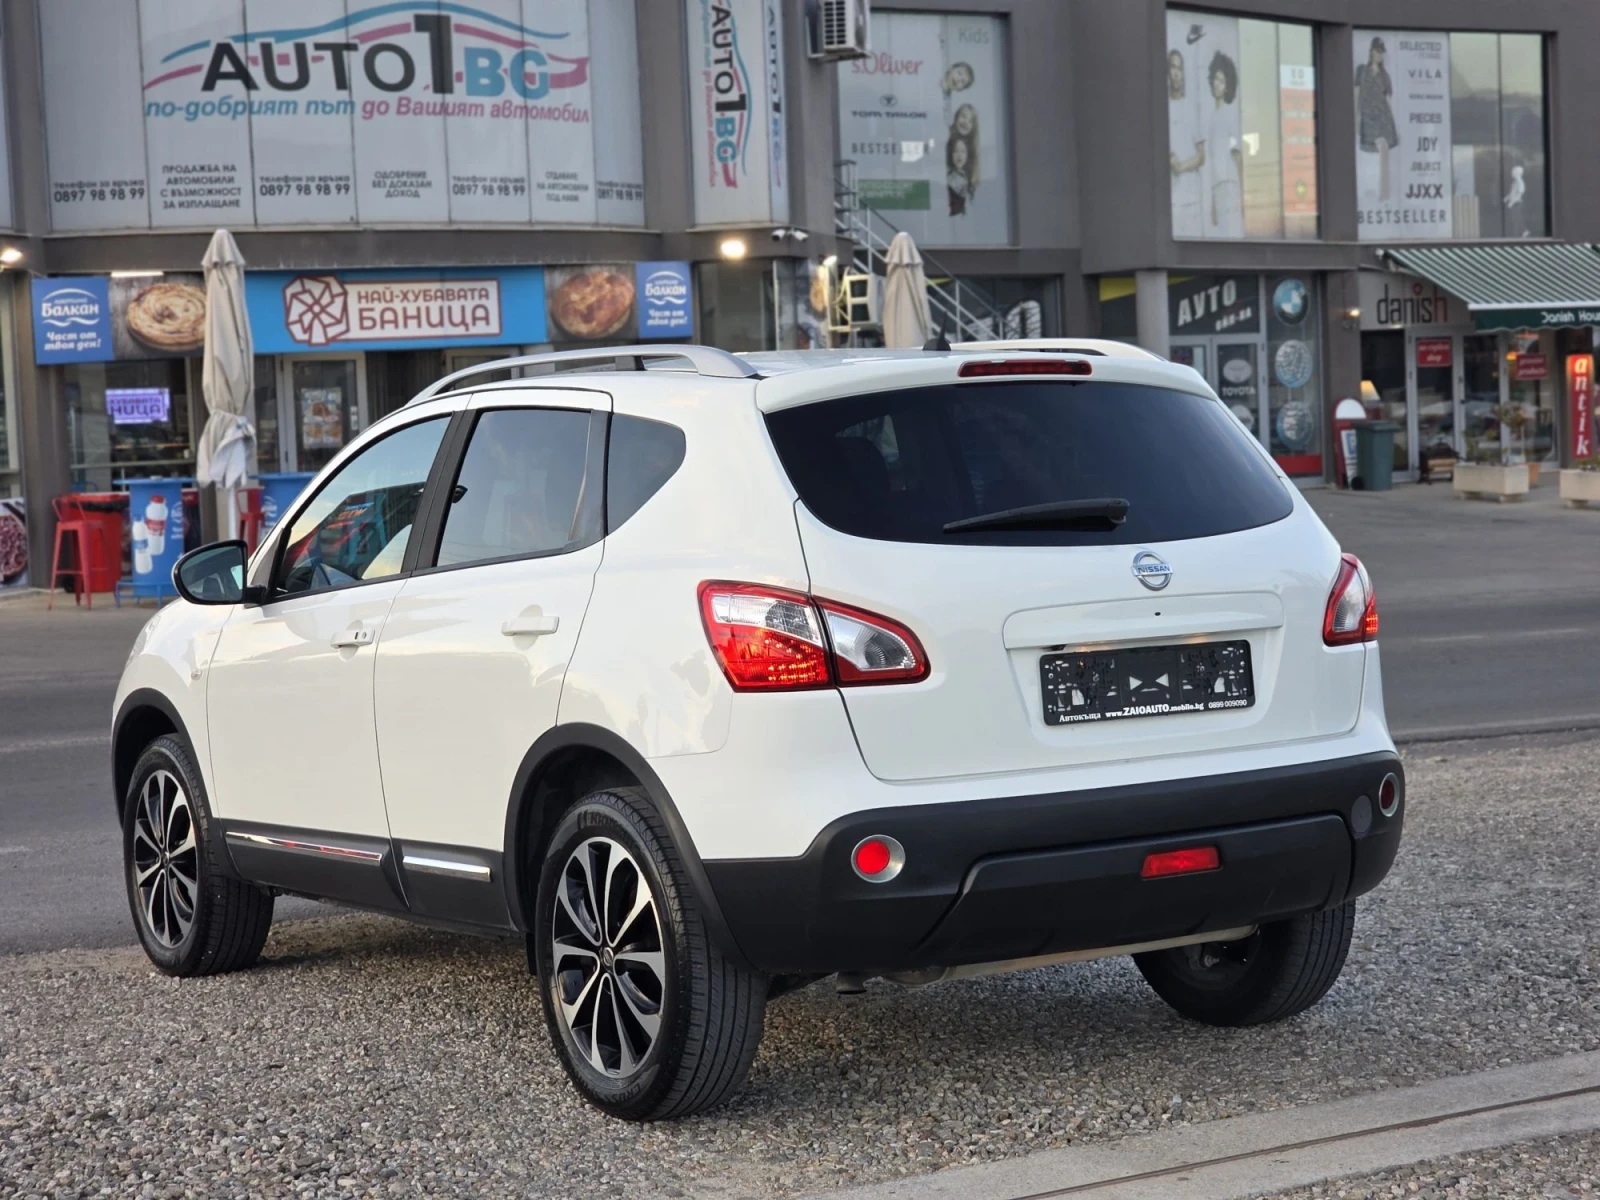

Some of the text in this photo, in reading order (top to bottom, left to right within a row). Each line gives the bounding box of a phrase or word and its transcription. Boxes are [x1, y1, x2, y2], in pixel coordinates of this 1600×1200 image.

[958, 28, 989, 44] Kids
[851, 53, 923, 75] s.Oliver
[1408, 69, 1442, 79] VILA
[145, 94, 590, 123] по-добрият път до Вашият автомобил
[851, 110, 928, 120] TOM TAILOR
[1409, 111, 1442, 124] PIECES
[851, 142, 929, 155] BESTSER
[1417, 136, 1438, 152] JDY
[161, 164, 237, 174] ПРОДАЖБА НА
[374, 170, 427, 180] ОДОБРЕНИЕ
[166, 175, 235, 186] АВТОМОБИЛИ
[372, 179, 432, 189] БЕЗ ДОКАЗАН
[54, 188, 146, 204] 0897 98 98 99
[160, 187, 242, 198] С ВЪЗМОЖНОСТ
[260, 184, 350, 197] 0897 98 98 99
[385, 189, 421, 199] ДОХОД
[453, 183, 526, 197] 0897 98 98 99
[1405, 183, 1443, 199] JJXX
[163, 199, 241, 210] ЗА ИЗПЛАЩАНЕ
[1357, 209, 1446, 225] BESTSELLER
[357, 287, 490, 304] НАЙ-ХУБАВАТА
[42, 302, 99, 317] Балкан
[1376, 282, 1448, 325] danish
[358, 303, 490, 332] БАНИЦА
[1541, 310, 1600, 324] Danish Hou
[46, 331, 97, 341] Част от
[77, 338, 102, 352] ден!
[1222, 386, 1256, 396] TOYOTA
[1575, 358, 1590, 455] antik
[1138, 565, 1170, 574] NISSAN
[1059, 712, 1101, 723] Автокъща
[1208, 700, 1225, 709] 0899
